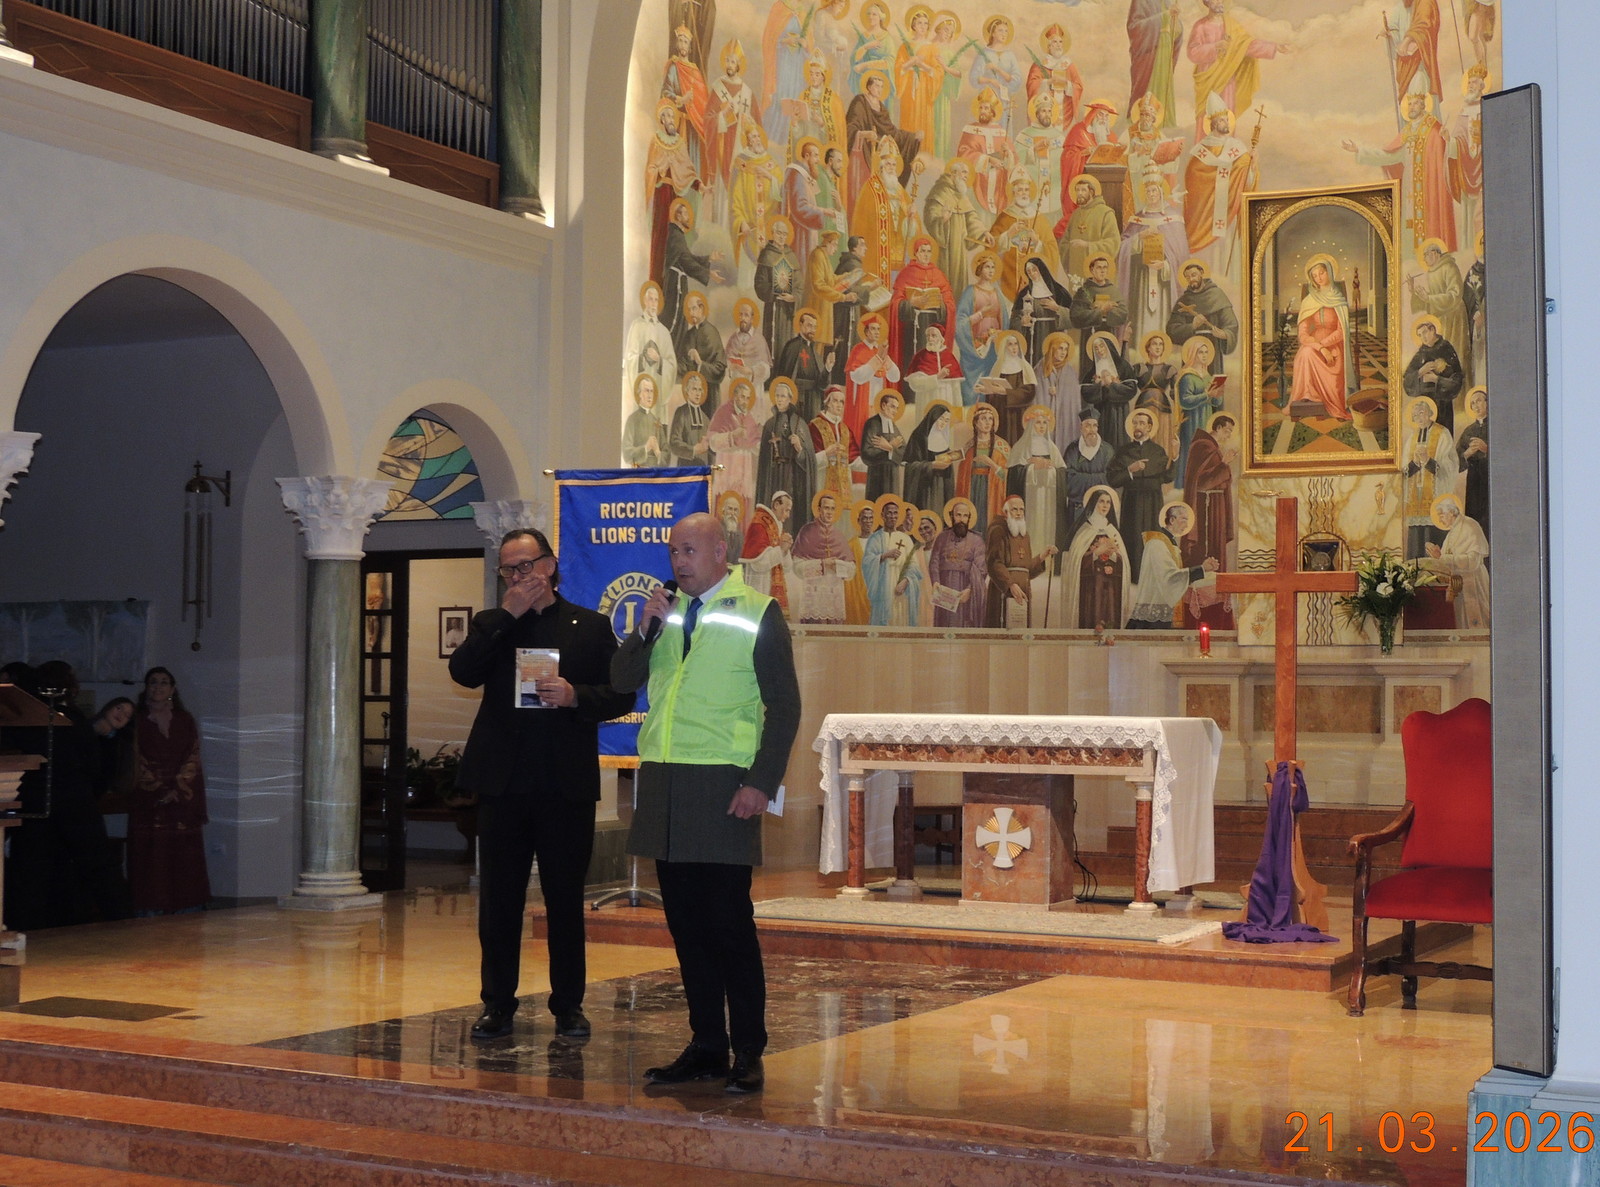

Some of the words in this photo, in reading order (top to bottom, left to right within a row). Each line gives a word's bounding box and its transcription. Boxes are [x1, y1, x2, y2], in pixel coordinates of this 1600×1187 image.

[600, 502, 674, 519] RICCIONE
[591, 527, 636, 544] LIONS
[640, 526, 671, 544] CLU
